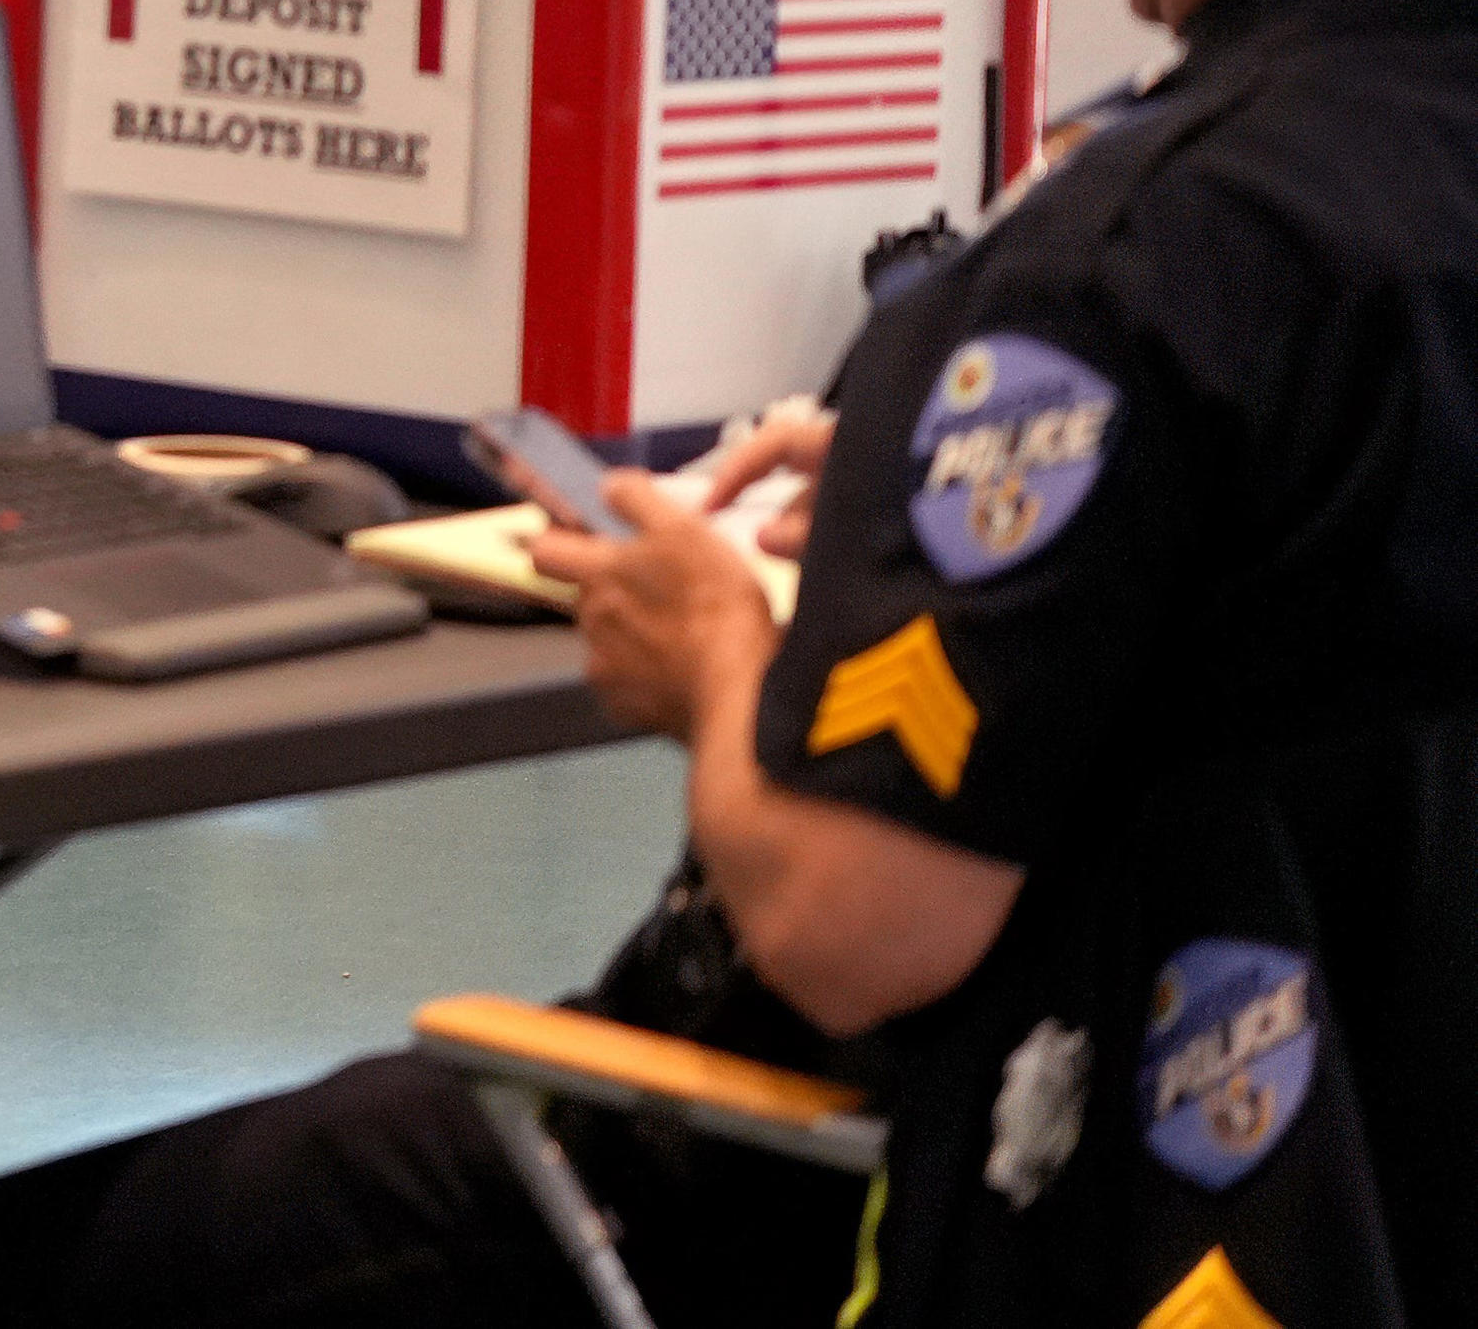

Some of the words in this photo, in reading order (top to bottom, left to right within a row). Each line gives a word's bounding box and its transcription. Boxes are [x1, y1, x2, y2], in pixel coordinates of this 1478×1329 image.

[181, 43, 367, 107] SIGNED
[112, 100, 303, 158] BALLOTS
[313, 123, 431, 180] HERE
[923, 400, 1111, 496] POLICE
[1154, 972, 1309, 1120] POLICE
